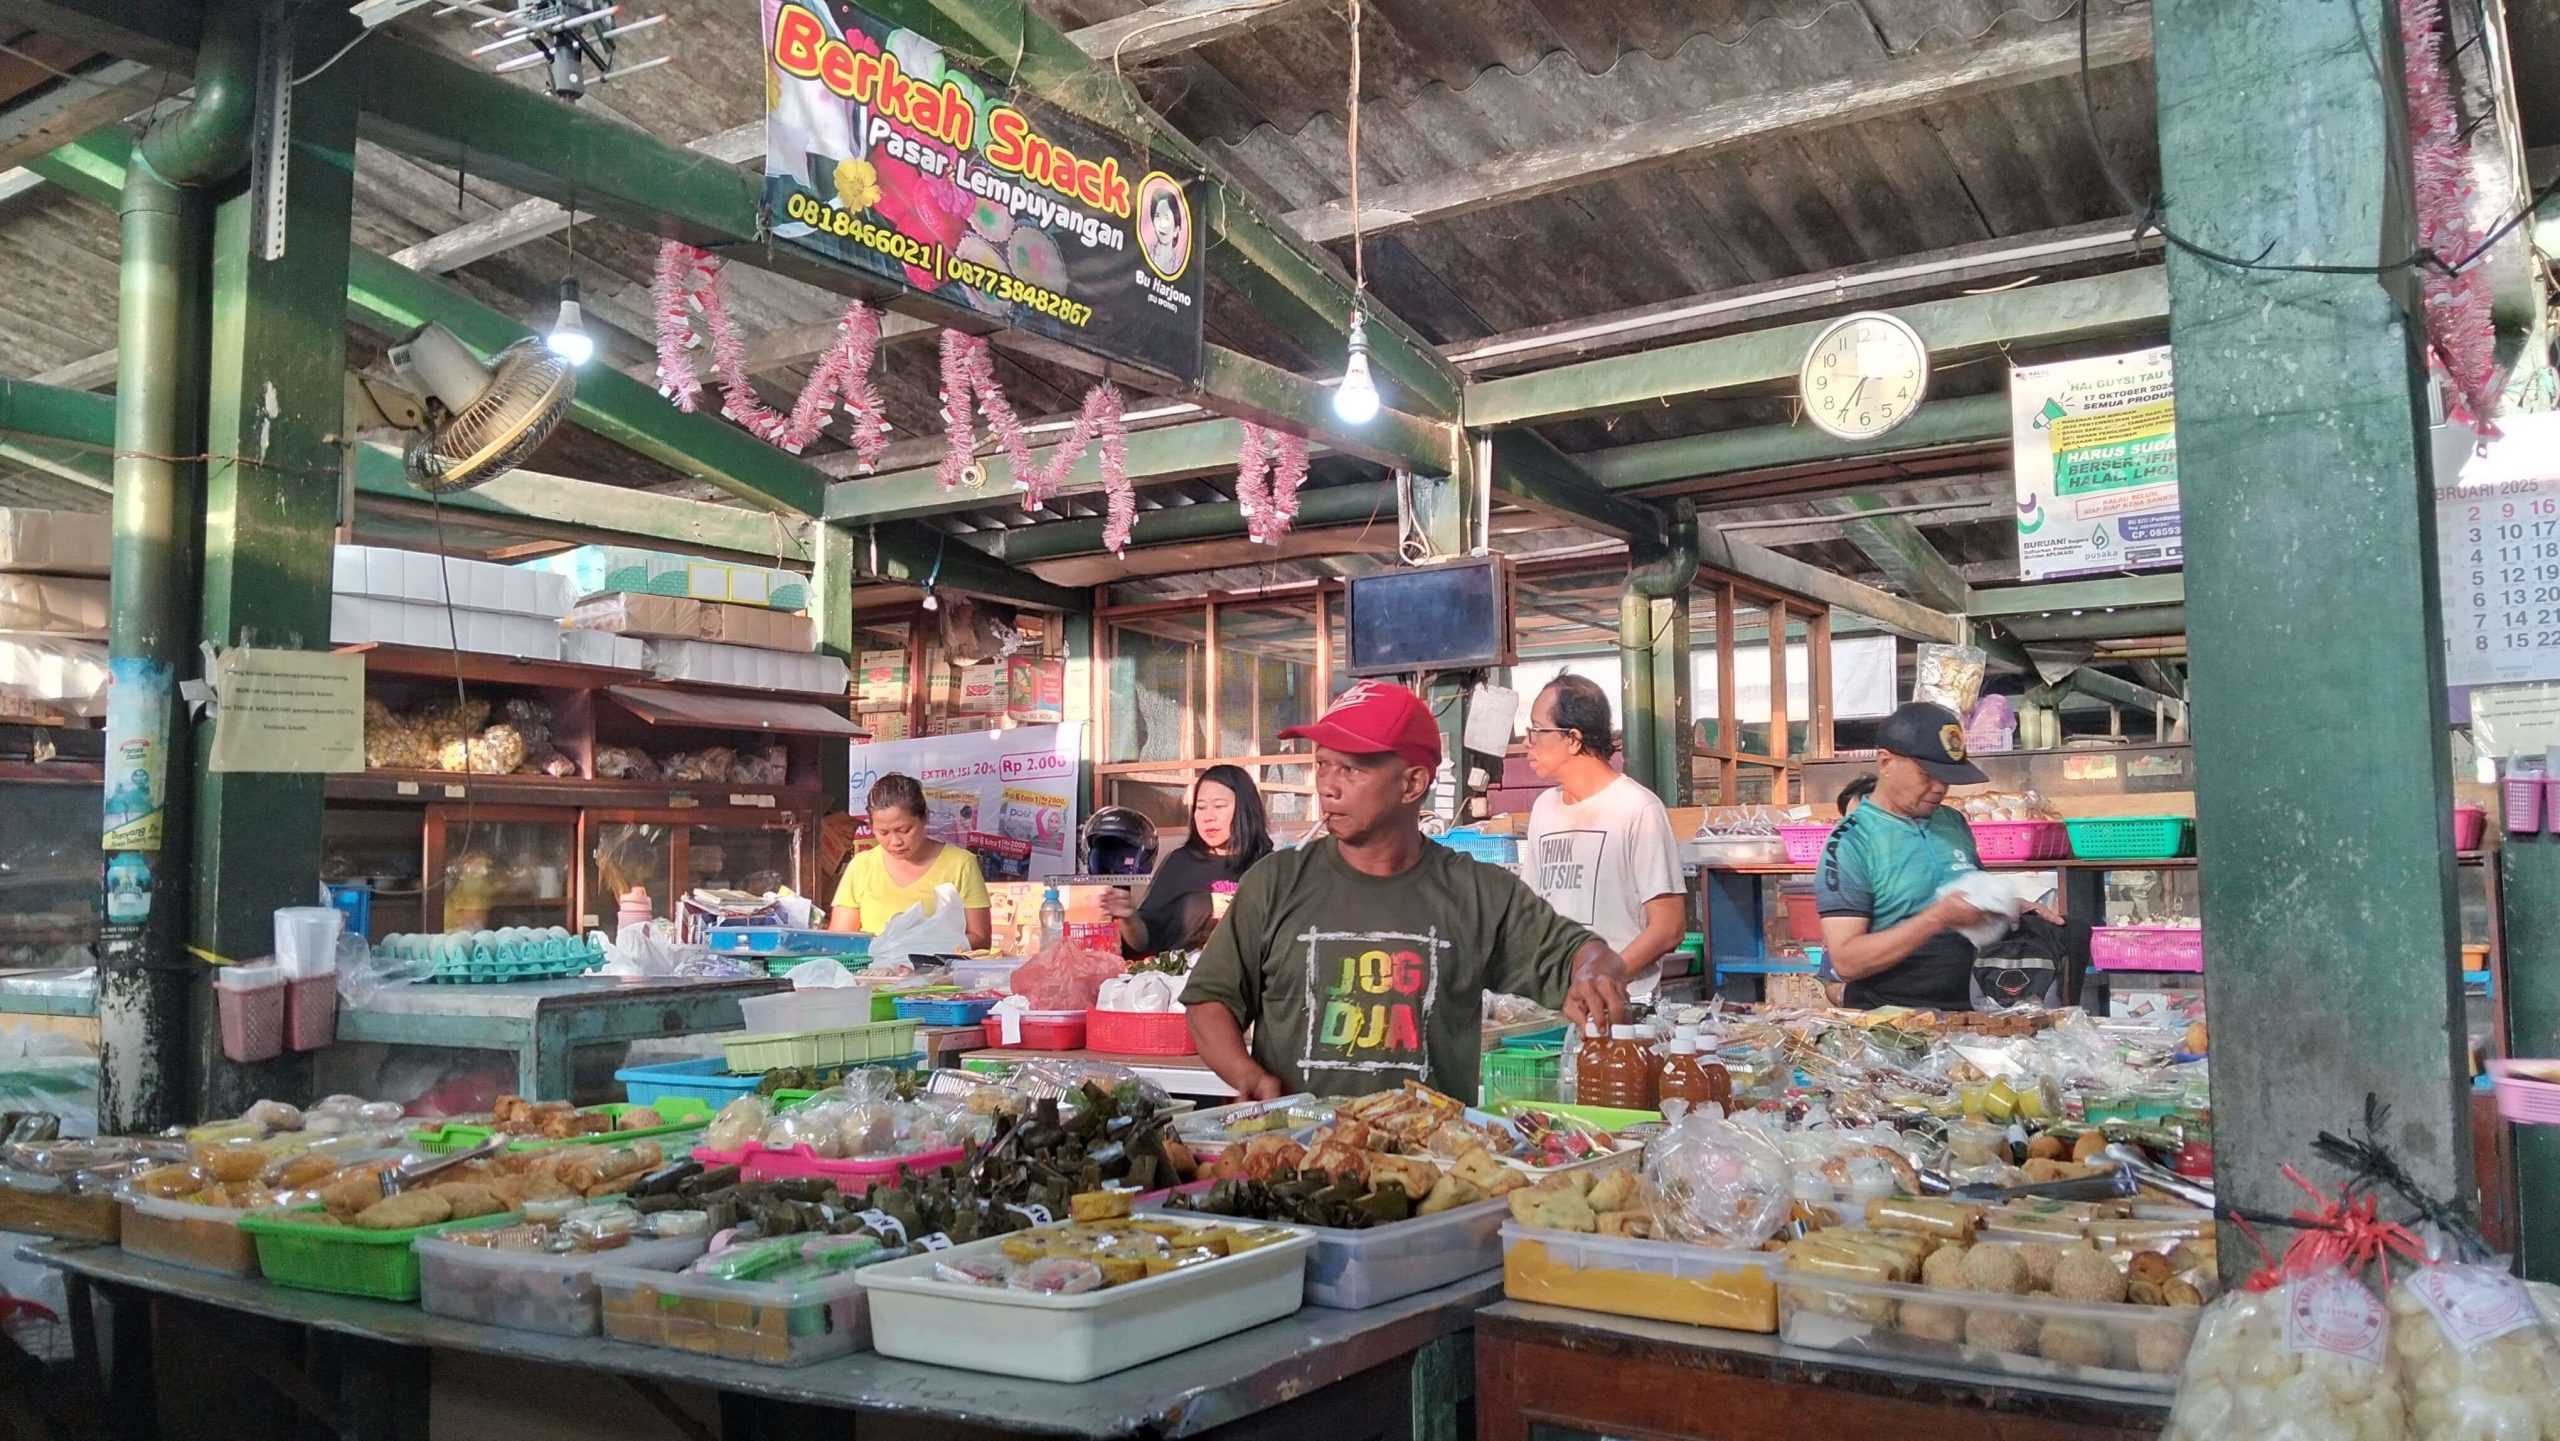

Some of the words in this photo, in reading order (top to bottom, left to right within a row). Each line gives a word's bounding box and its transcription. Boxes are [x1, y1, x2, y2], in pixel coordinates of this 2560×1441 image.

[774, 3, 975, 151] Berkah
[986, 107, 1131, 219] Snack
[868, 116, 948, 177] Pasar
[955, 157, 1125, 252] Lempuyangan
[786, 193, 932, 270] 0818466021
[947, 258, 1094, 329] 087738482867
[1136, 269, 1151, 288] Bu
[1152, 277, 1192, 307] Harjono
[1839, 337, 1847, 351] 11
[1823, 353, 1837, 368] 10
[1816, 376, 1827, 390] 9
[2139, 370, 2164, 383] TAU
[1897, 386, 1908, 400] 4
[2084, 394, 2095, 402] 17
[2098, 387, 2147, 401] OKTOBER
[1823, 395, 1835, 410] 8
[1881, 403, 1893, 419] 5
[2083, 399, 2123, 411] SEMUA
[1840, 408, 1850, 424] 7
[1859, 411, 1871, 426] 6
[2067, 446, 2126, 463] HARUS
[2130, 438, 2177, 455] SUDA
[2501, 479, 2538, 495] 2025
[2102, 495, 2129, 505] KALAU
[2467, 506, 2480, 521] 2
[2502, 503, 2515, 517] 9
[2529, 499, 2555, 514] 16
[2131, 531, 2148, 539] CP.
[2469, 527, 2482, 542] 3
[2496, 524, 2523, 540] 10
[2531, 520, 2557, 537] 17
[2023, 537, 2067, 549] BURUAN!
[2085, 550, 2118, 561] pusaka
[2470, 549, 2483, 564] 4
[2498, 546, 2521, 561] 11
[2532, 542, 2558, 558] 18
[2472, 571, 2484, 586] 5
[2500, 567, 2525, 583] 12
[2534, 564, 2559, 580] 19
[2473, 592, 2486, 607] 6
[2501, 589, 2527, 605] 13
[2534, 586, 2560, 602] 20
[2473, 614, 2487, 628] 7
[2502, 610, 2528, 627] 14
[2475, 635, 2488, 650] 8
[2503, 633, 2529, 648] 15
[921, 769, 956, 780] EXTRA
[974, 762, 996, 775] 20%
[1002, 759, 1022, 776] Rp
[1027, 755, 1067, 771] 2.000
[1541, 838, 1574, 865] THINK
[1825, 815, 1859, 892] GIANT
[1325, 950, 1424, 996] JOG
[1319, 1000, 1419, 1053] DJA
